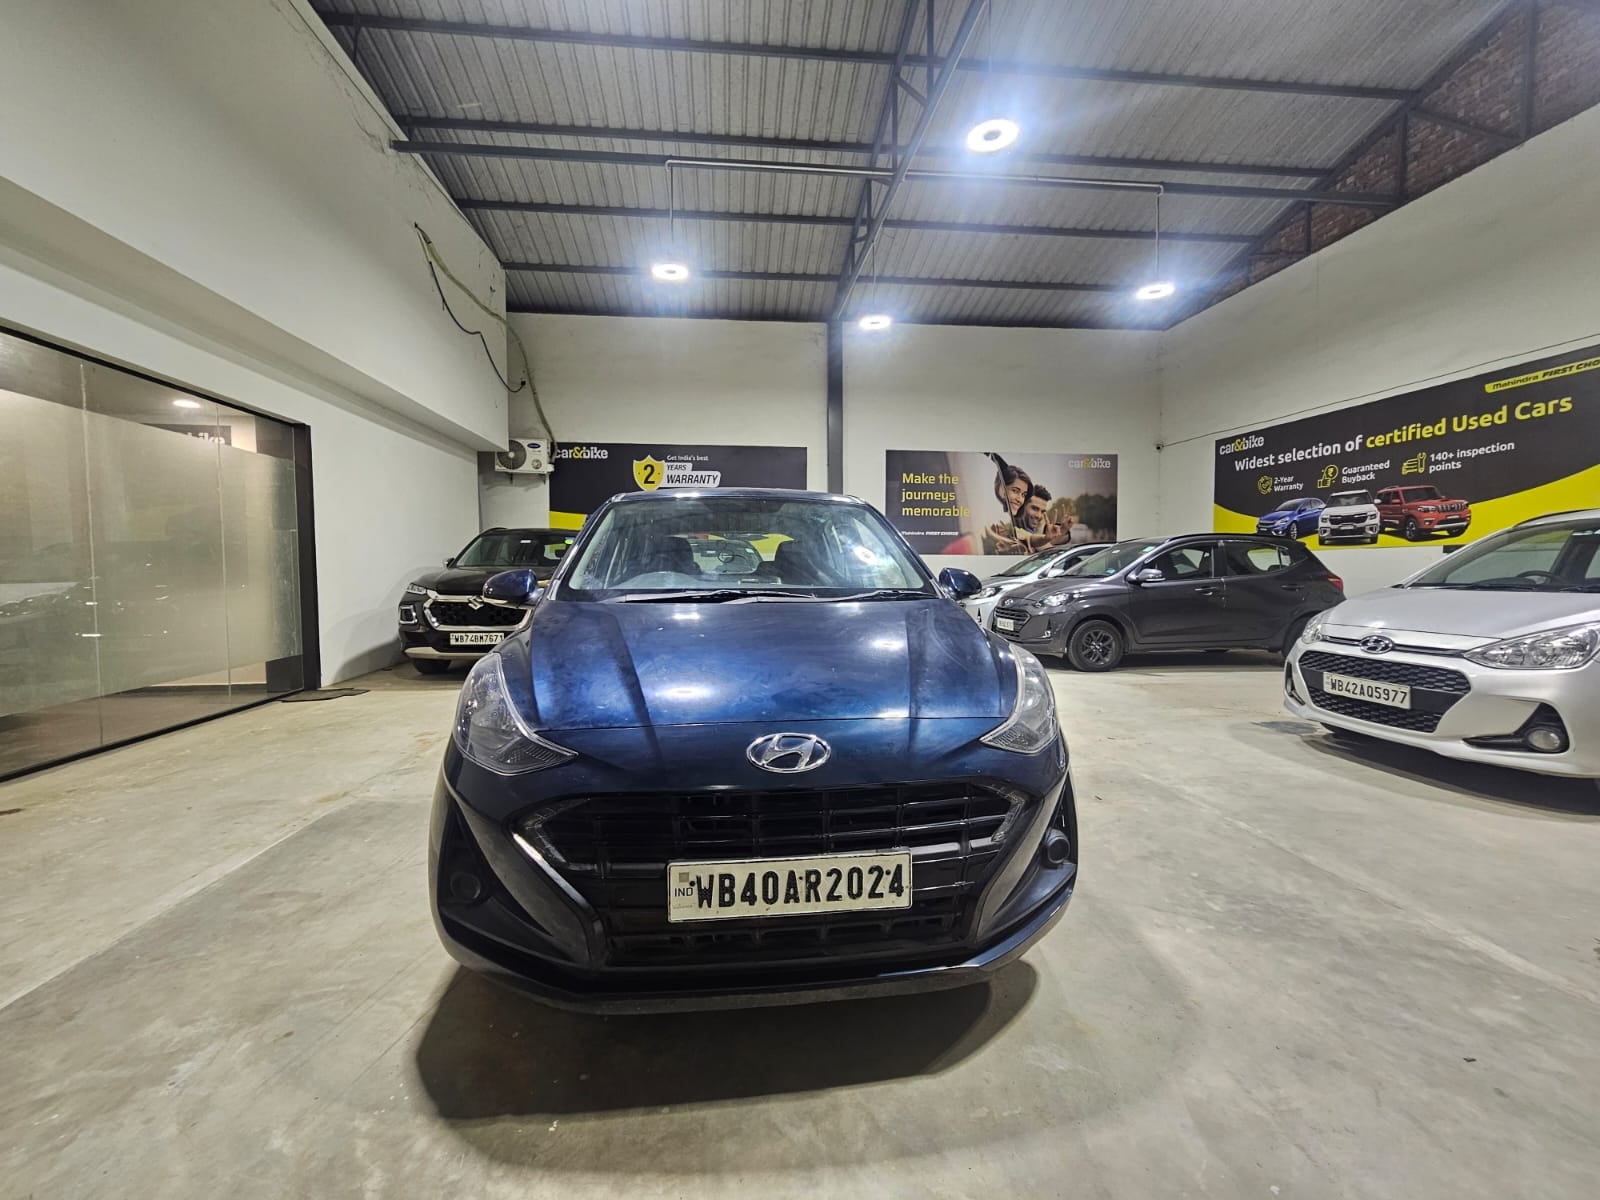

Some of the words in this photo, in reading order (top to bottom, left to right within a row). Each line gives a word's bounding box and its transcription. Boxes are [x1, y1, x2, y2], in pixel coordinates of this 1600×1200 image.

[1492, 375, 1539, 390] Mahindra
[1542, 365, 1575, 378] FIRST
[1235, 453, 1275, 471] Widest
[1277, 443, 1341, 464] selection
[1344, 434, 1363, 452] of
[1366, 418, 1446, 448] certified
[1452, 405, 1507, 432] Used
[1514, 397, 1573, 420] Cars
[1219, 435, 1265, 455] car&bike
[1430, 451, 1454, 462] 140+
[1456, 441, 1515, 459] inspection
[1341, 460, 1390, 475] Guaranteed
[1429, 460, 1461, 474] points
[643, 464, 656, 485] 2
[666, 474, 719, 484] WARRANTY
[902, 472, 935, 484] Make
[939, 473, 959, 485] the
[1274, 476, 1294, 484] 2-Year
[1341, 472, 1376, 485] Buyback
[1274, 482, 1304, 492] Warranty
[902, 488, 956, 502] journeys
[902, 505, 970, 517] memorable
[1330, 678, 1408, 704] WB42AQ5977
[674, 887, 694, 897] IND
[695, 863, 905, 909] WB40AR2024
